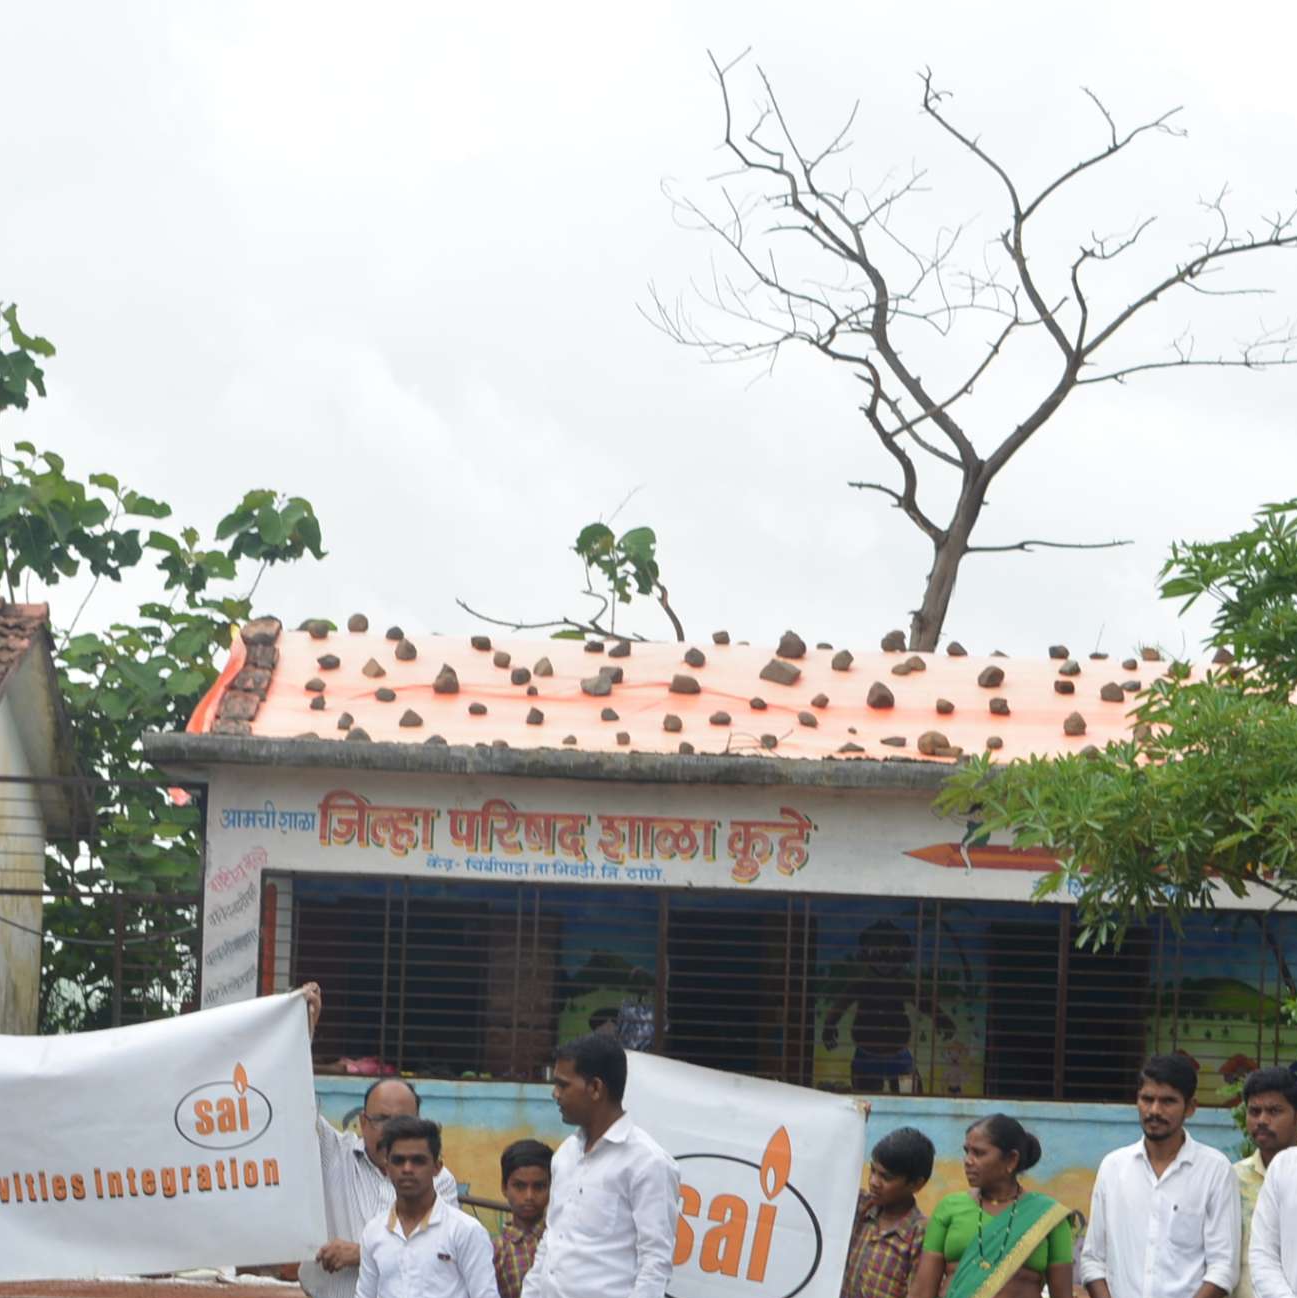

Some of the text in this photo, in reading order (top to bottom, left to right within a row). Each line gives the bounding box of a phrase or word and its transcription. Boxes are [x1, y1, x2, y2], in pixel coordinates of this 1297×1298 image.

[220, 801, 276, 830] आमची
[278, 810, 316, 834] शाळा
[318, 788, 441, 857] जिल्हा
[448, 799, 591, 861] परिषद
[597, 814, 721, 865] शाळा
[193, 1094, 252, 1137] sai
[94, 1155, 280, 1200] integration
